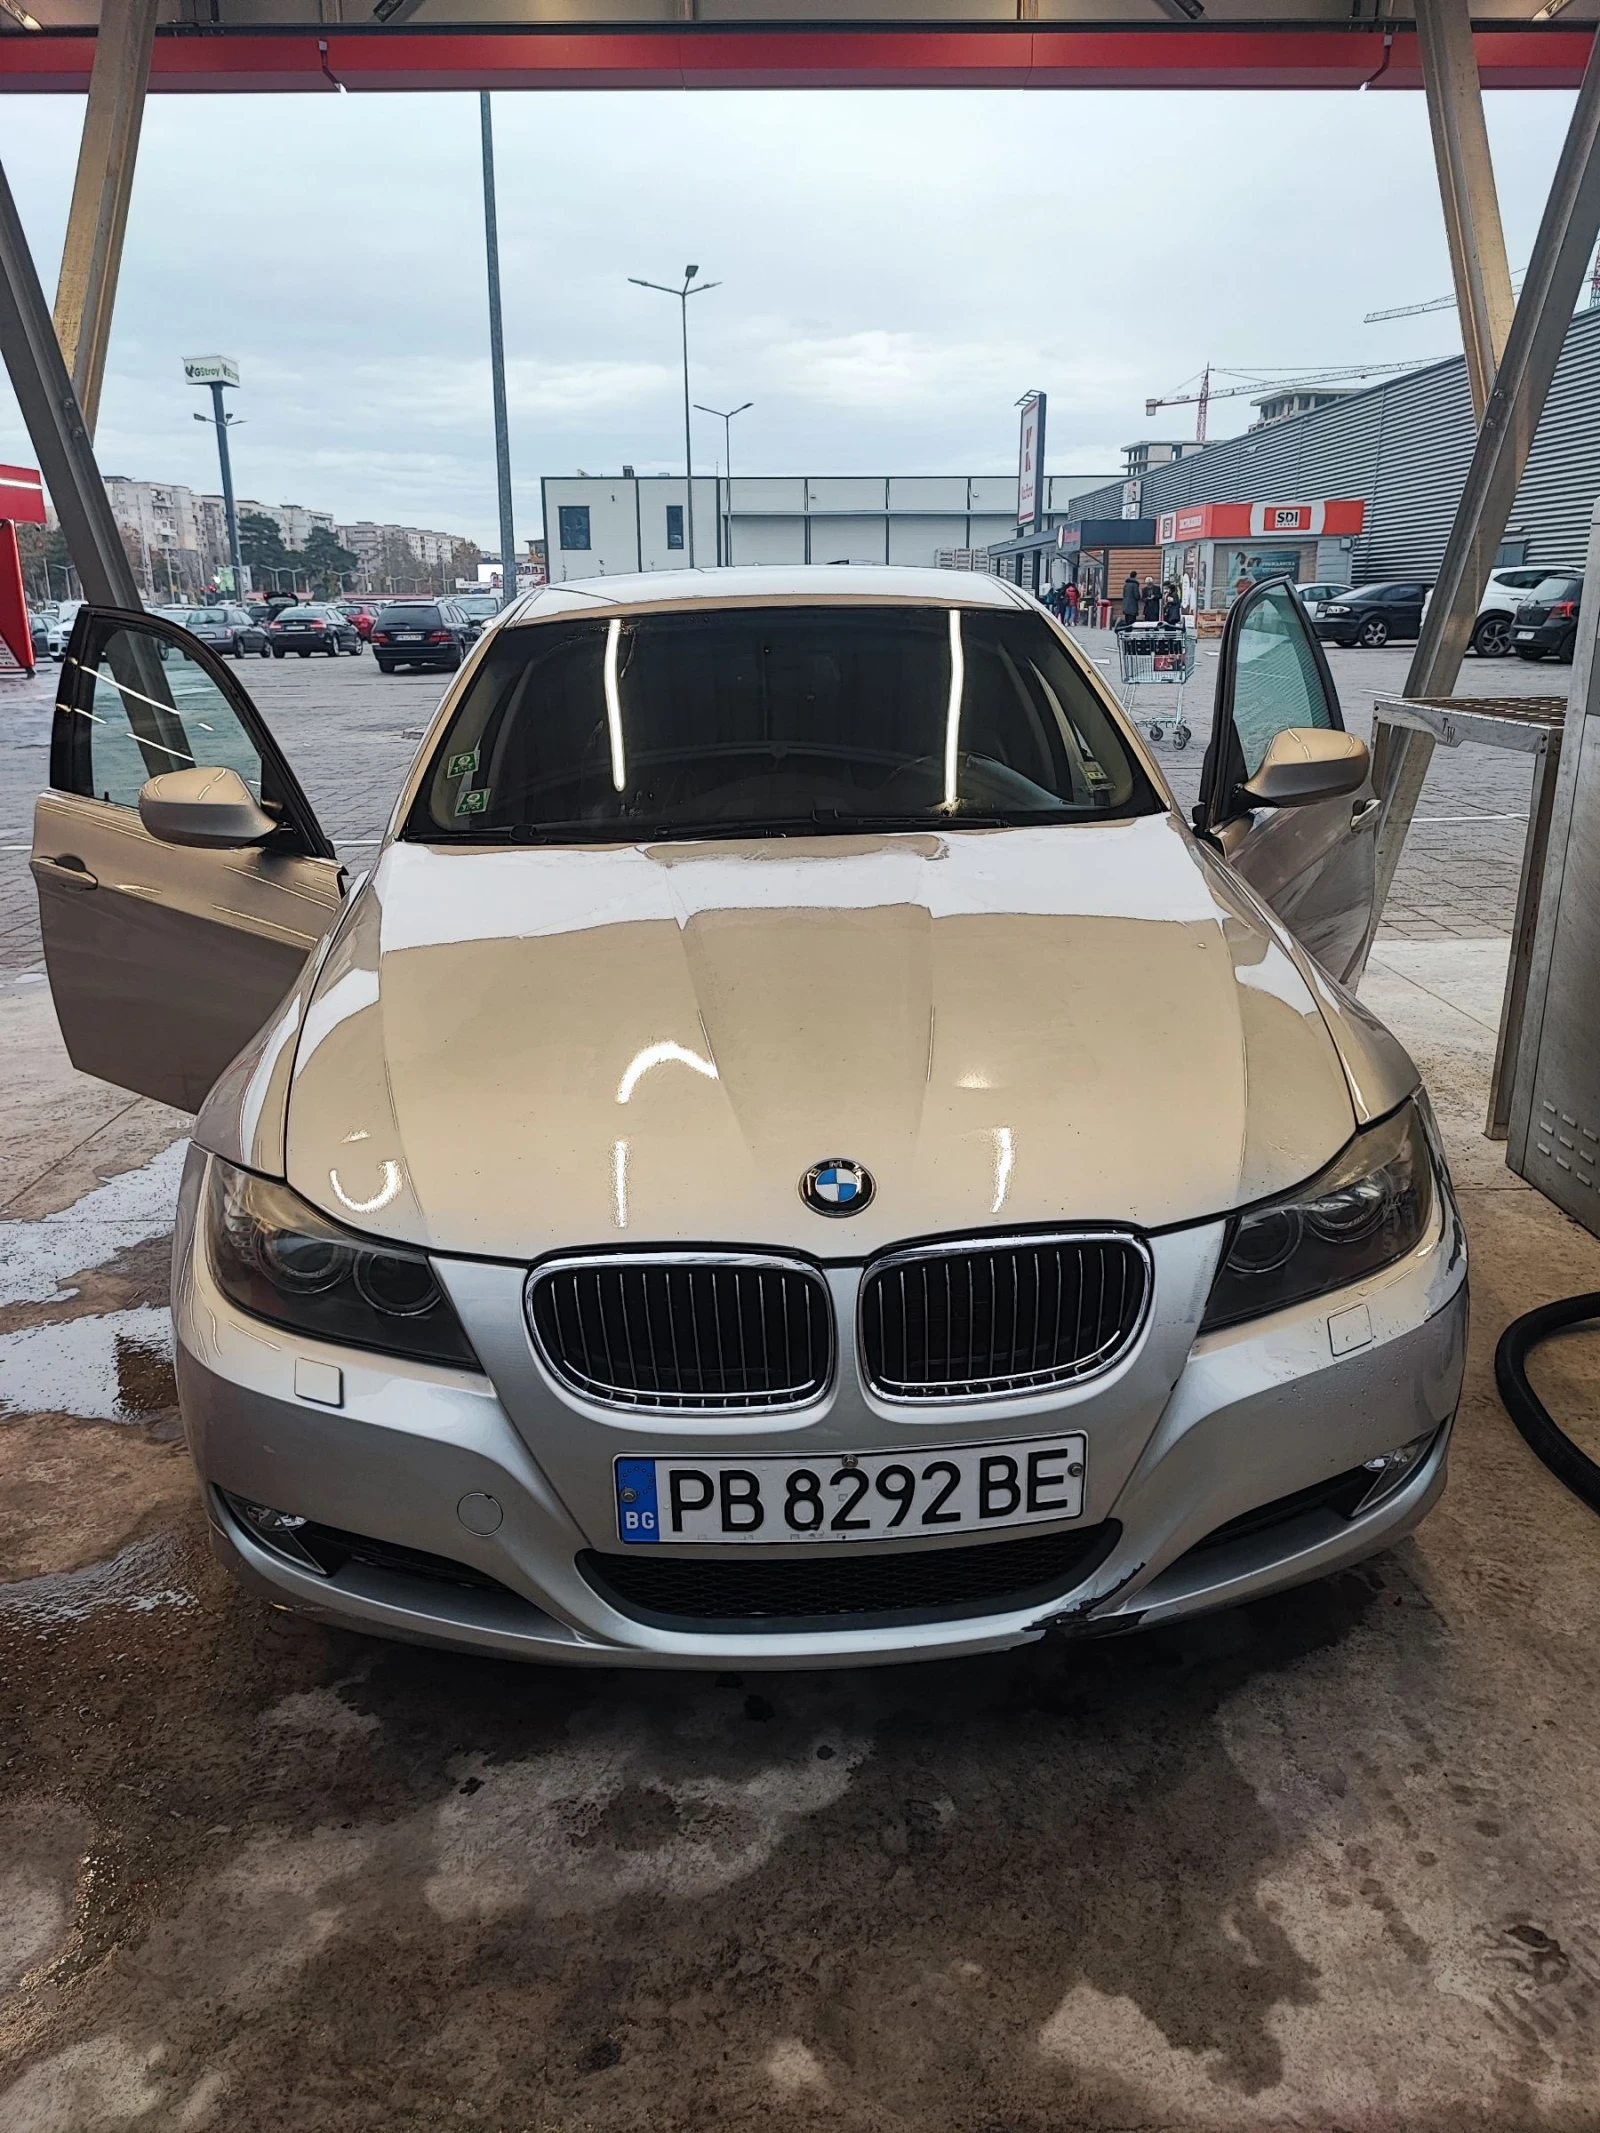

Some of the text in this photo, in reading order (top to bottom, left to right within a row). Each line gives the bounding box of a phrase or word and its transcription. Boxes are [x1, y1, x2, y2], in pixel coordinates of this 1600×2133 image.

[1276, 511, 1299, 523] SDI
[669, 1448, 1069, 1533] PB 8292 BE
[625, 1511, 655, 1530] BG
